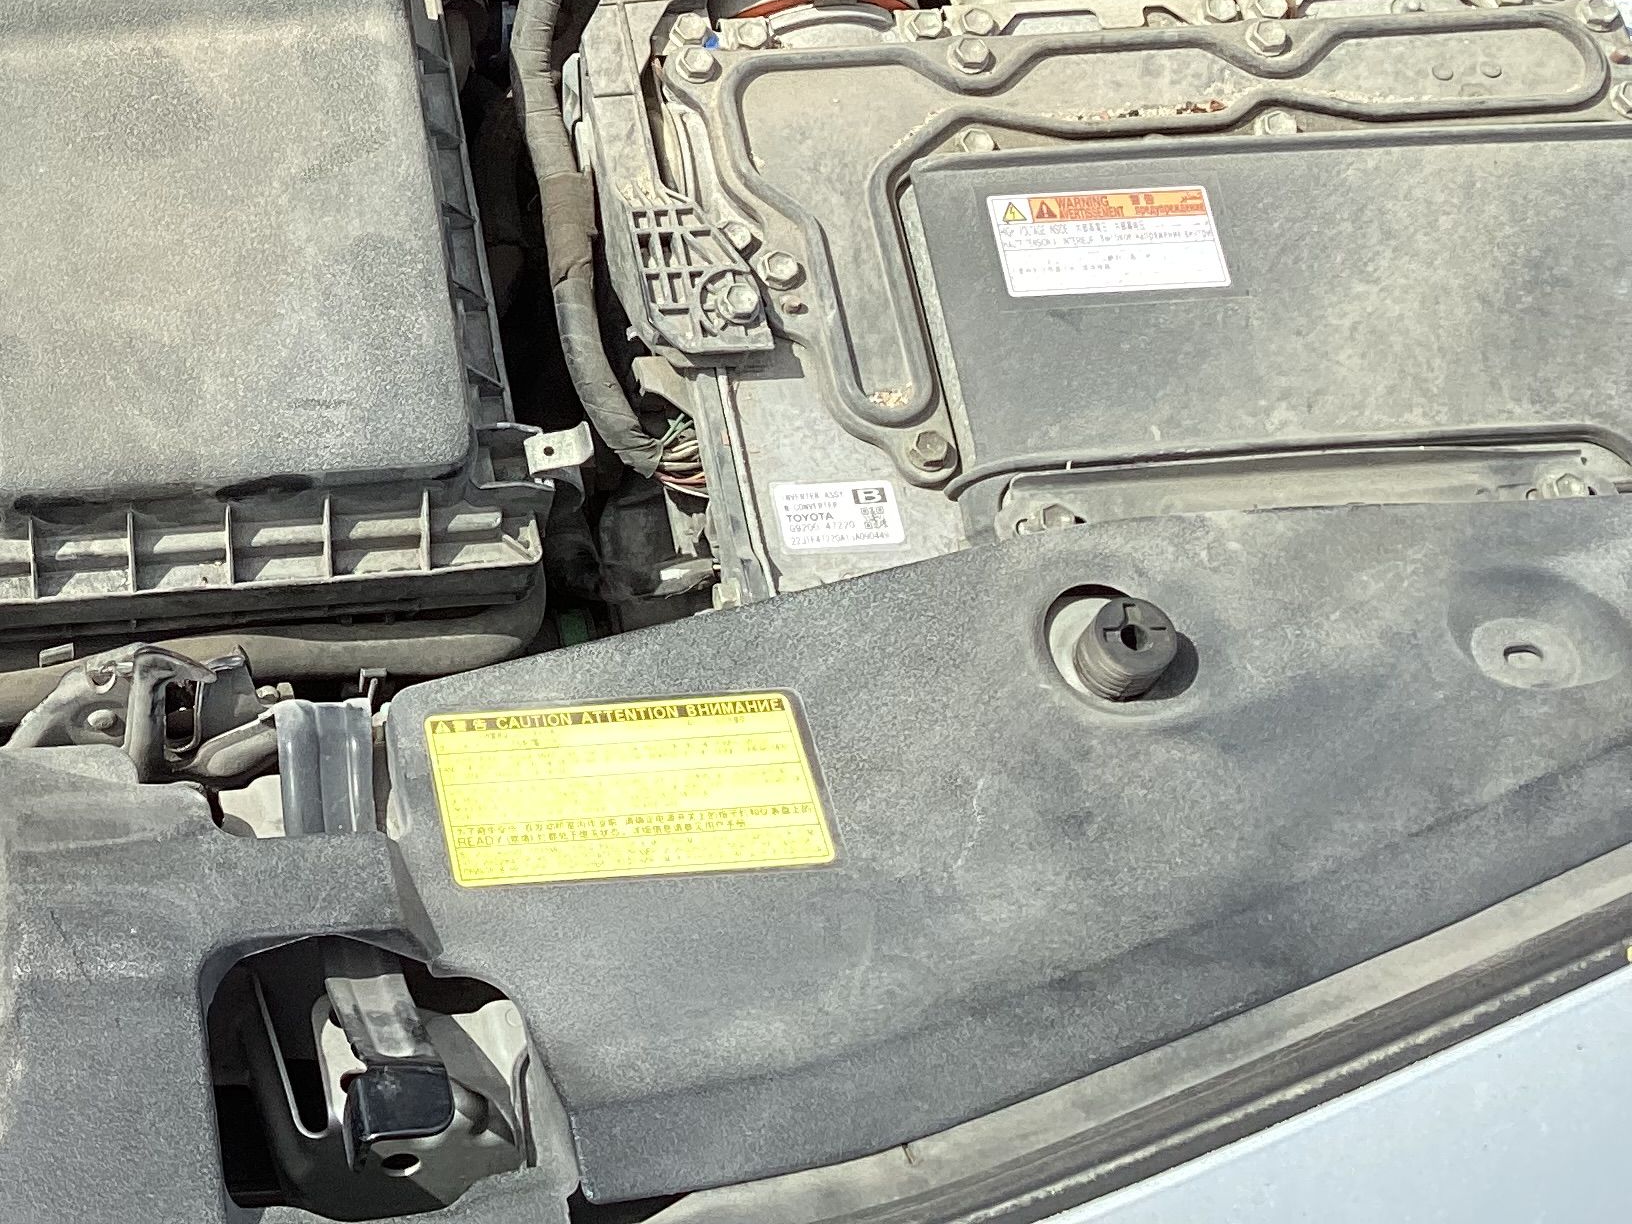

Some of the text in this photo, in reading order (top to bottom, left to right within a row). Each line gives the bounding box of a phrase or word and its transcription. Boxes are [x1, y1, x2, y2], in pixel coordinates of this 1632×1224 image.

[1055, 195, 1109, 208] WARNING
[857, 488, 883, 504] B
[786, 512, 834, 523] TOYOTA
[496, 712, 572, 730] CAUTION
[581, 705, 679, 726] ATTENTION
[687, 698, 782, 718] ВНИМАНИЕ
